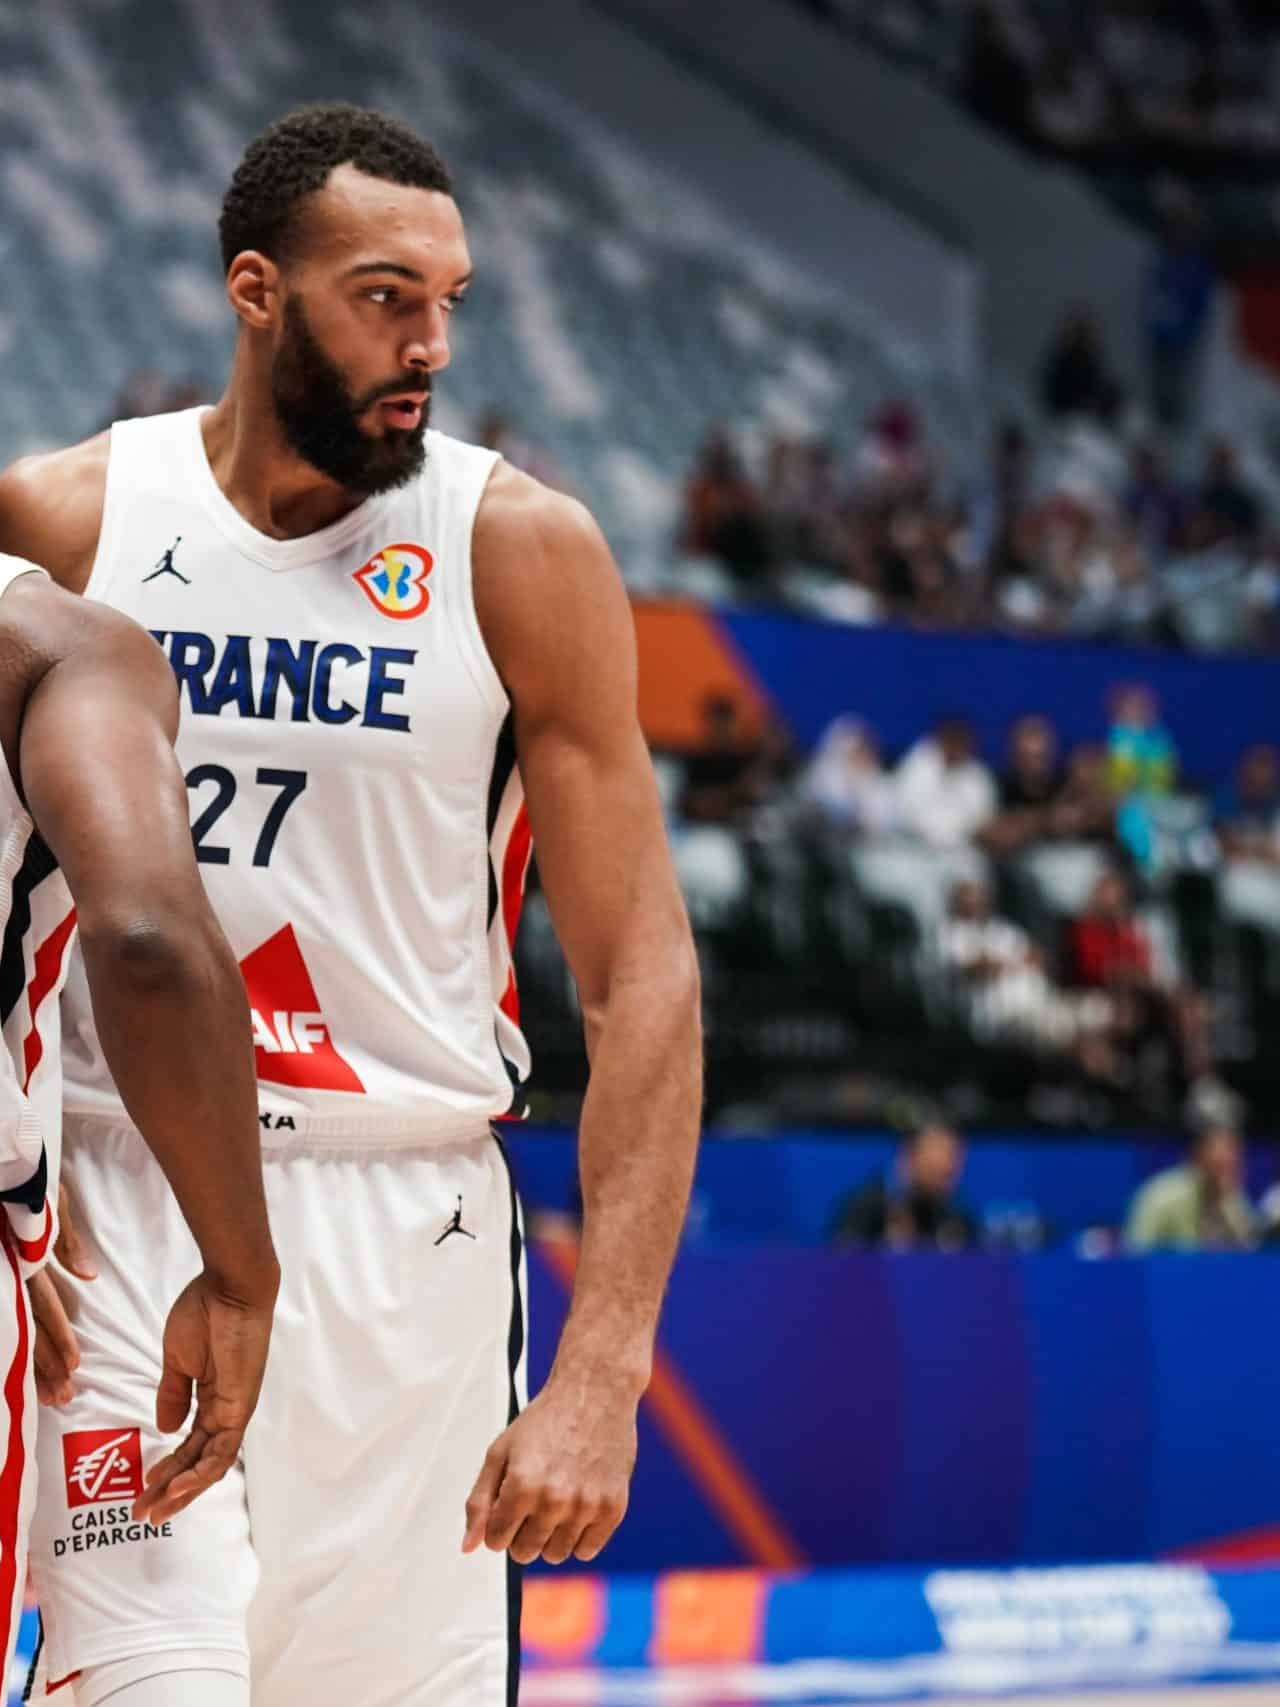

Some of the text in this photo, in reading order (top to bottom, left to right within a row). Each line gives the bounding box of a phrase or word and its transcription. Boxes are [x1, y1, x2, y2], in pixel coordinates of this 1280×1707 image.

[184, 764, 308, 868] 27
[251, 1007, 328, 1053] AIF
[53, 1521, 173, 1557] D'EPARGNE
[71, 1506, 129, 1531] CAISS
